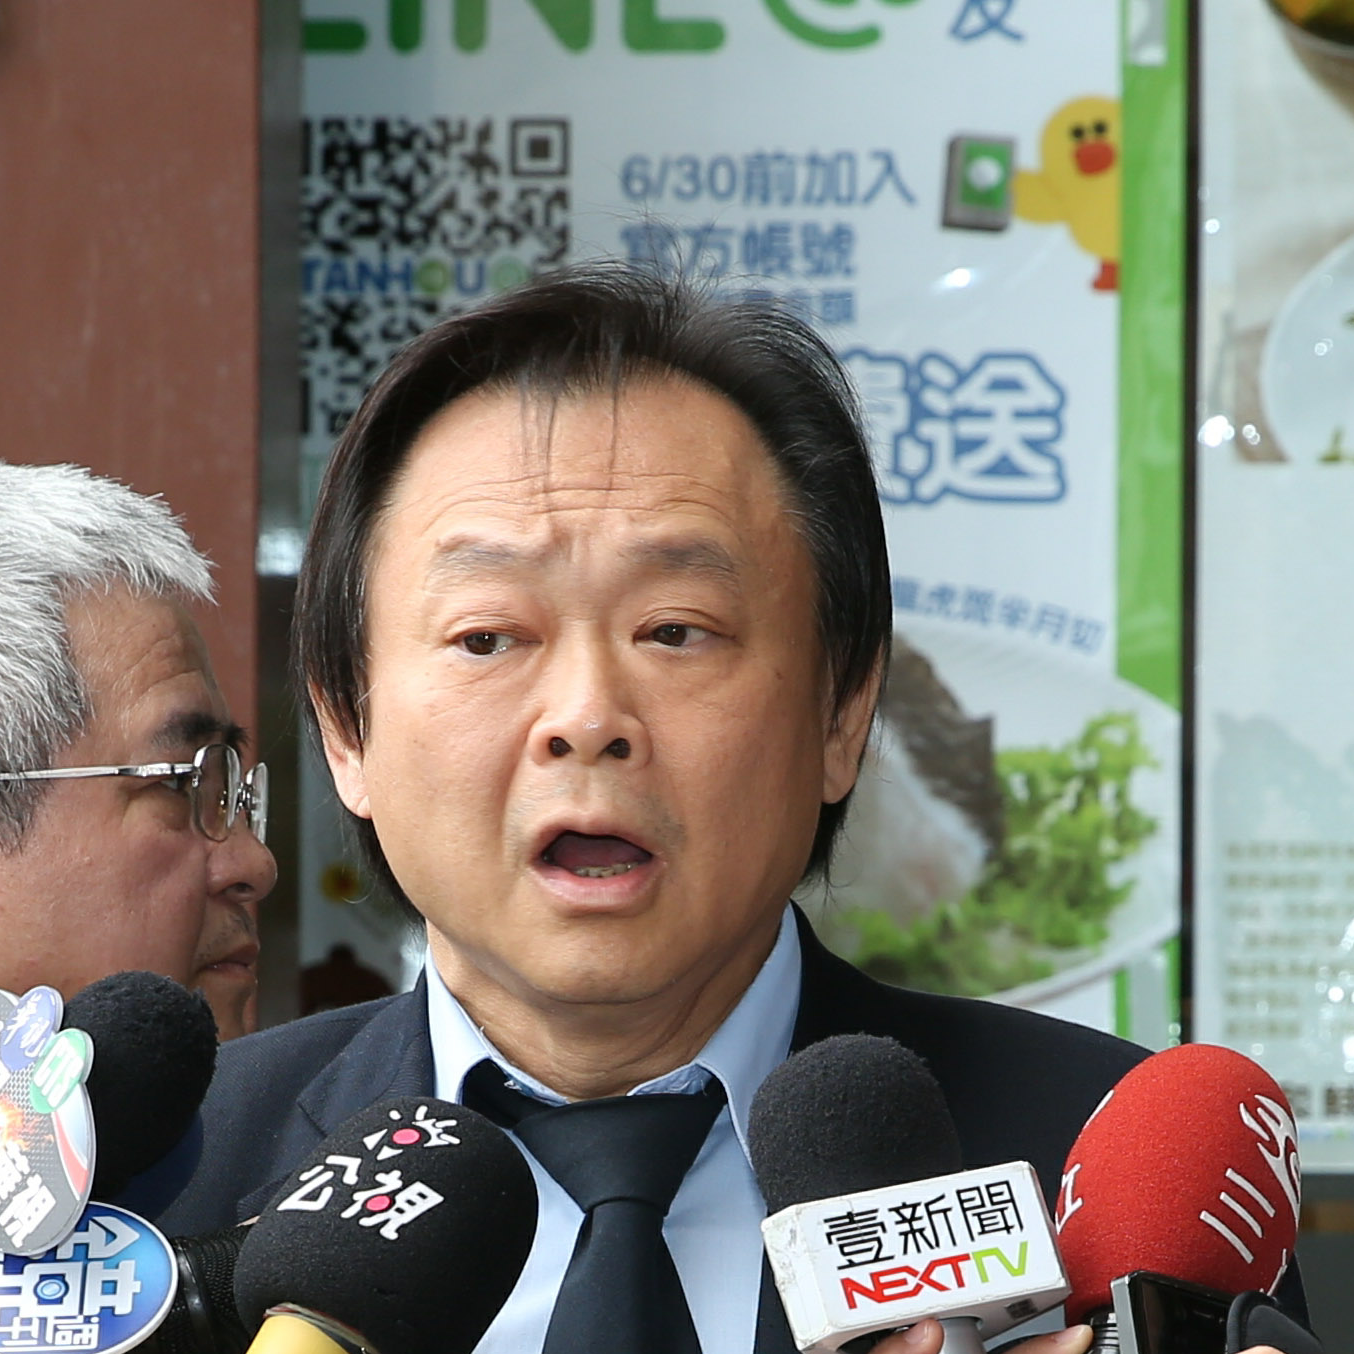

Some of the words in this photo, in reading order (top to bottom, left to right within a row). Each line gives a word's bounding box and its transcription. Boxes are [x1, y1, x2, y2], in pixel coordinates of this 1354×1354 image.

[620, 148, 917, 206] 6/30前加入
[823, 1179, 1025, 1271] 壹新聞
